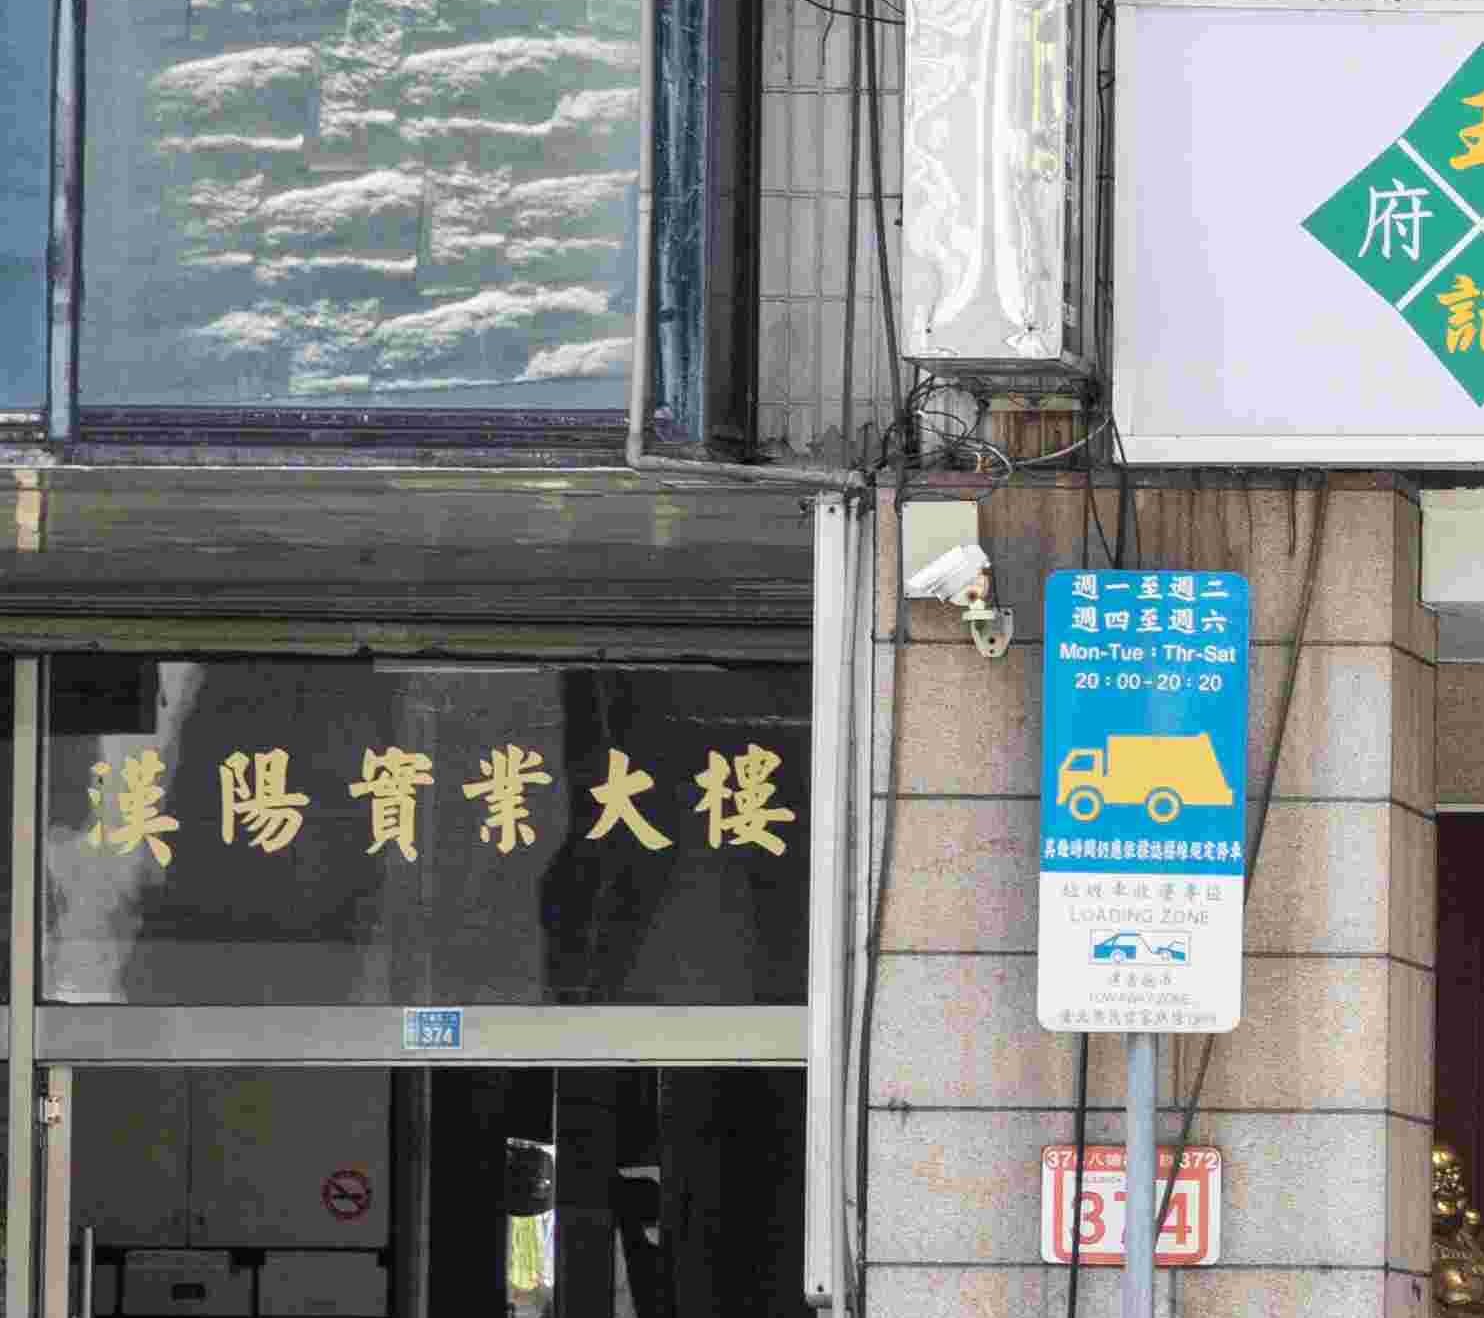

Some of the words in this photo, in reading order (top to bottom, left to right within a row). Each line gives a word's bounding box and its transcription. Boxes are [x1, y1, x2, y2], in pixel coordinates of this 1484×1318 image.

[1072, 573, 1231, 601] 週一至週二
[1071, 605, 1229, 634] 週四至週六
[1059, 642, 1145, 661] Mon-Tue
[1163, 643, 1237, 664] Thr-Sat
[87, 743, 797, 868] 漢陽實業大樓
[1069, 905, 1154, 925] LOADING
[1160, 909, 1210, 927] ZONE
[1179, 1152, 1217, 1169] 372
